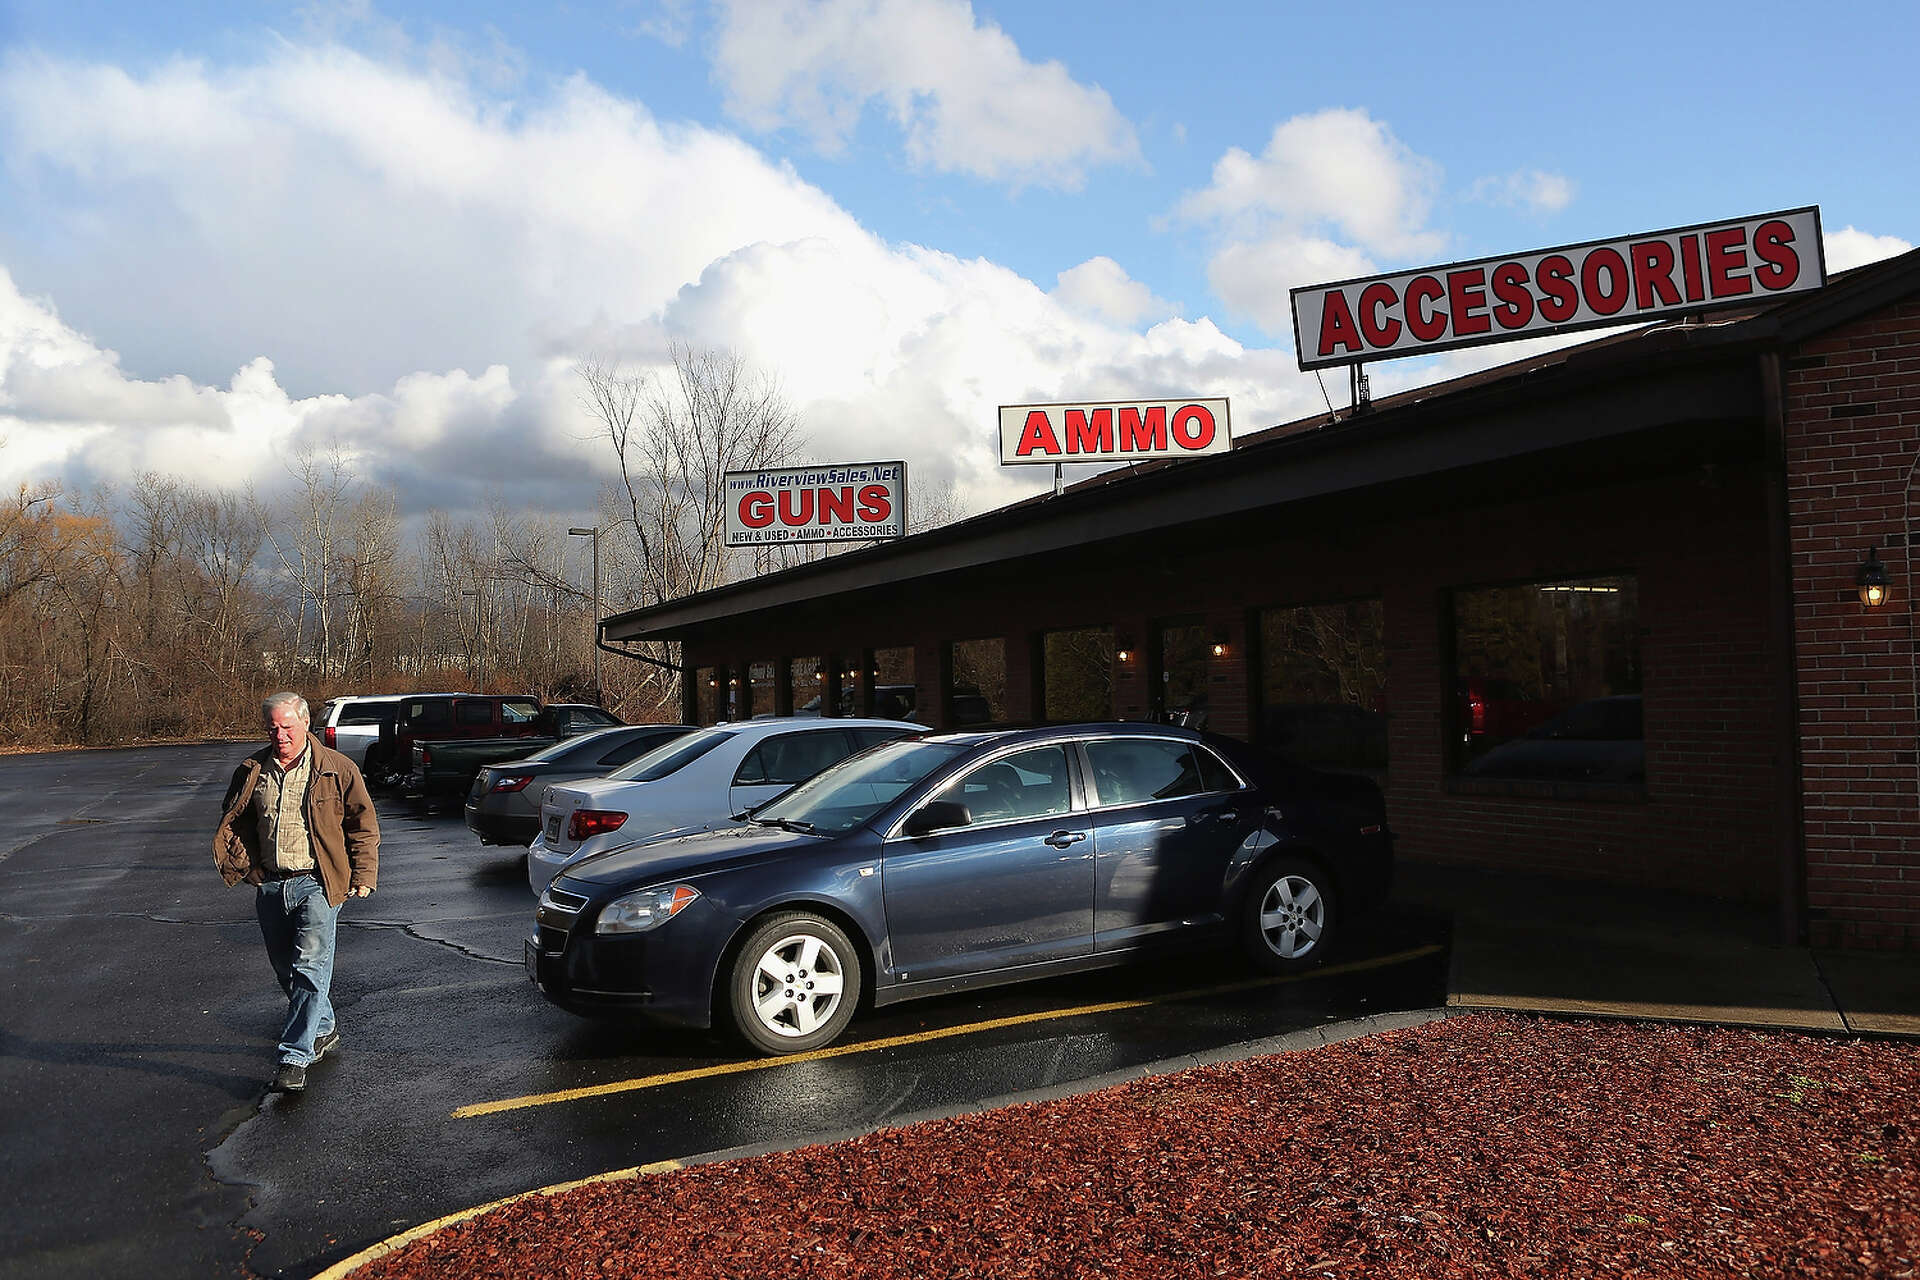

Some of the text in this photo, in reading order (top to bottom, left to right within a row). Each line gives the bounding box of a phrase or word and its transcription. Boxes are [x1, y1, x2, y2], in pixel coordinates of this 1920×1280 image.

[1317, 219, 1800, 356] ACCESSORIES
[1015, 404, 1216, 457] AMMO
[738, 484, 892, 529] GUNS
[732, 524, 898, 543] NEW & USED AMMO ACCESSORIES
